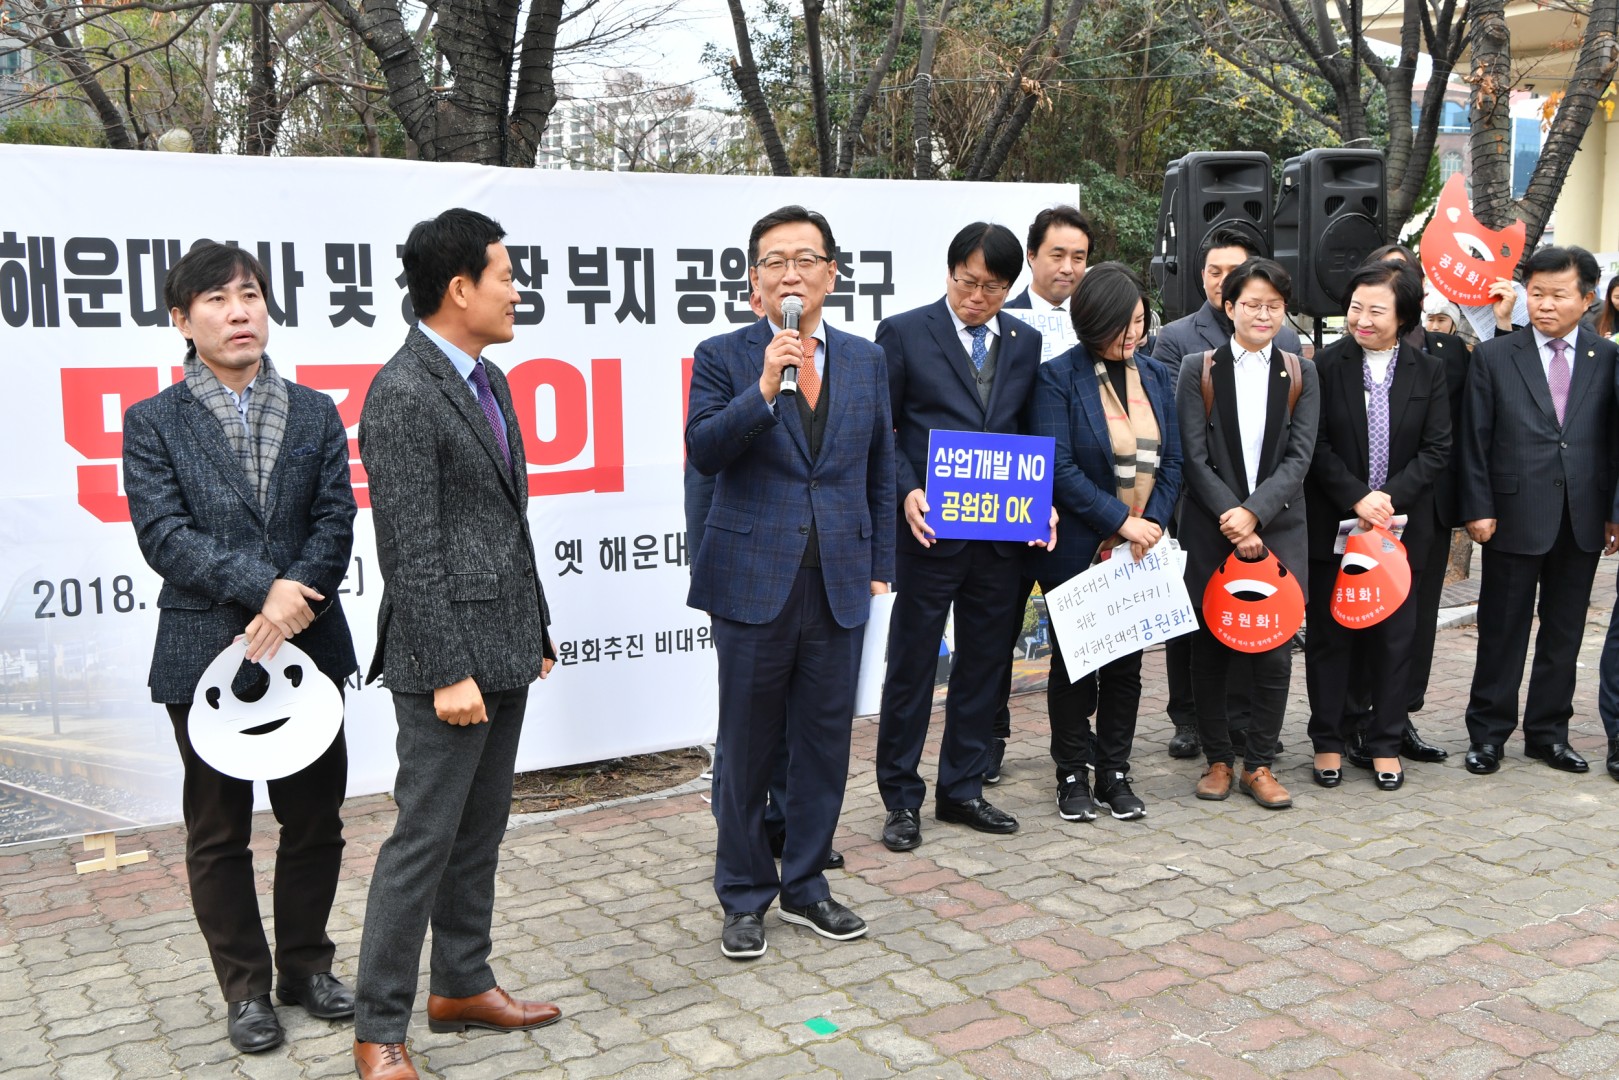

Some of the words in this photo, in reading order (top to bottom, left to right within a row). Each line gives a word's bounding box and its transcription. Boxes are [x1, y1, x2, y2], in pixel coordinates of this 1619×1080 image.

[0, 231, 304, 328] 해운대사
[325, 243, 376, 328] 및
[567, 246, 656, 325] 부지
[675, 247, 757, 325] 공원
[934, 447, 1013, 481] 상업개발
[1017, 453, 1046, 482] NO
[941, 491, 1000, 523] 공원화
[1005, 496, 1034, 524] OK
[554, 538, 583, 577] 옛
[33, 574, 146, 619] 2018.
[1057, 573, 1110, 612] 해운대의
[1113, 547, 1170, 581] 세계화를
[1076, 611, 1098, 631] 위한
[559, 634, 644, 666] 원화추진
[655, 626, 715, 654] 비대위
